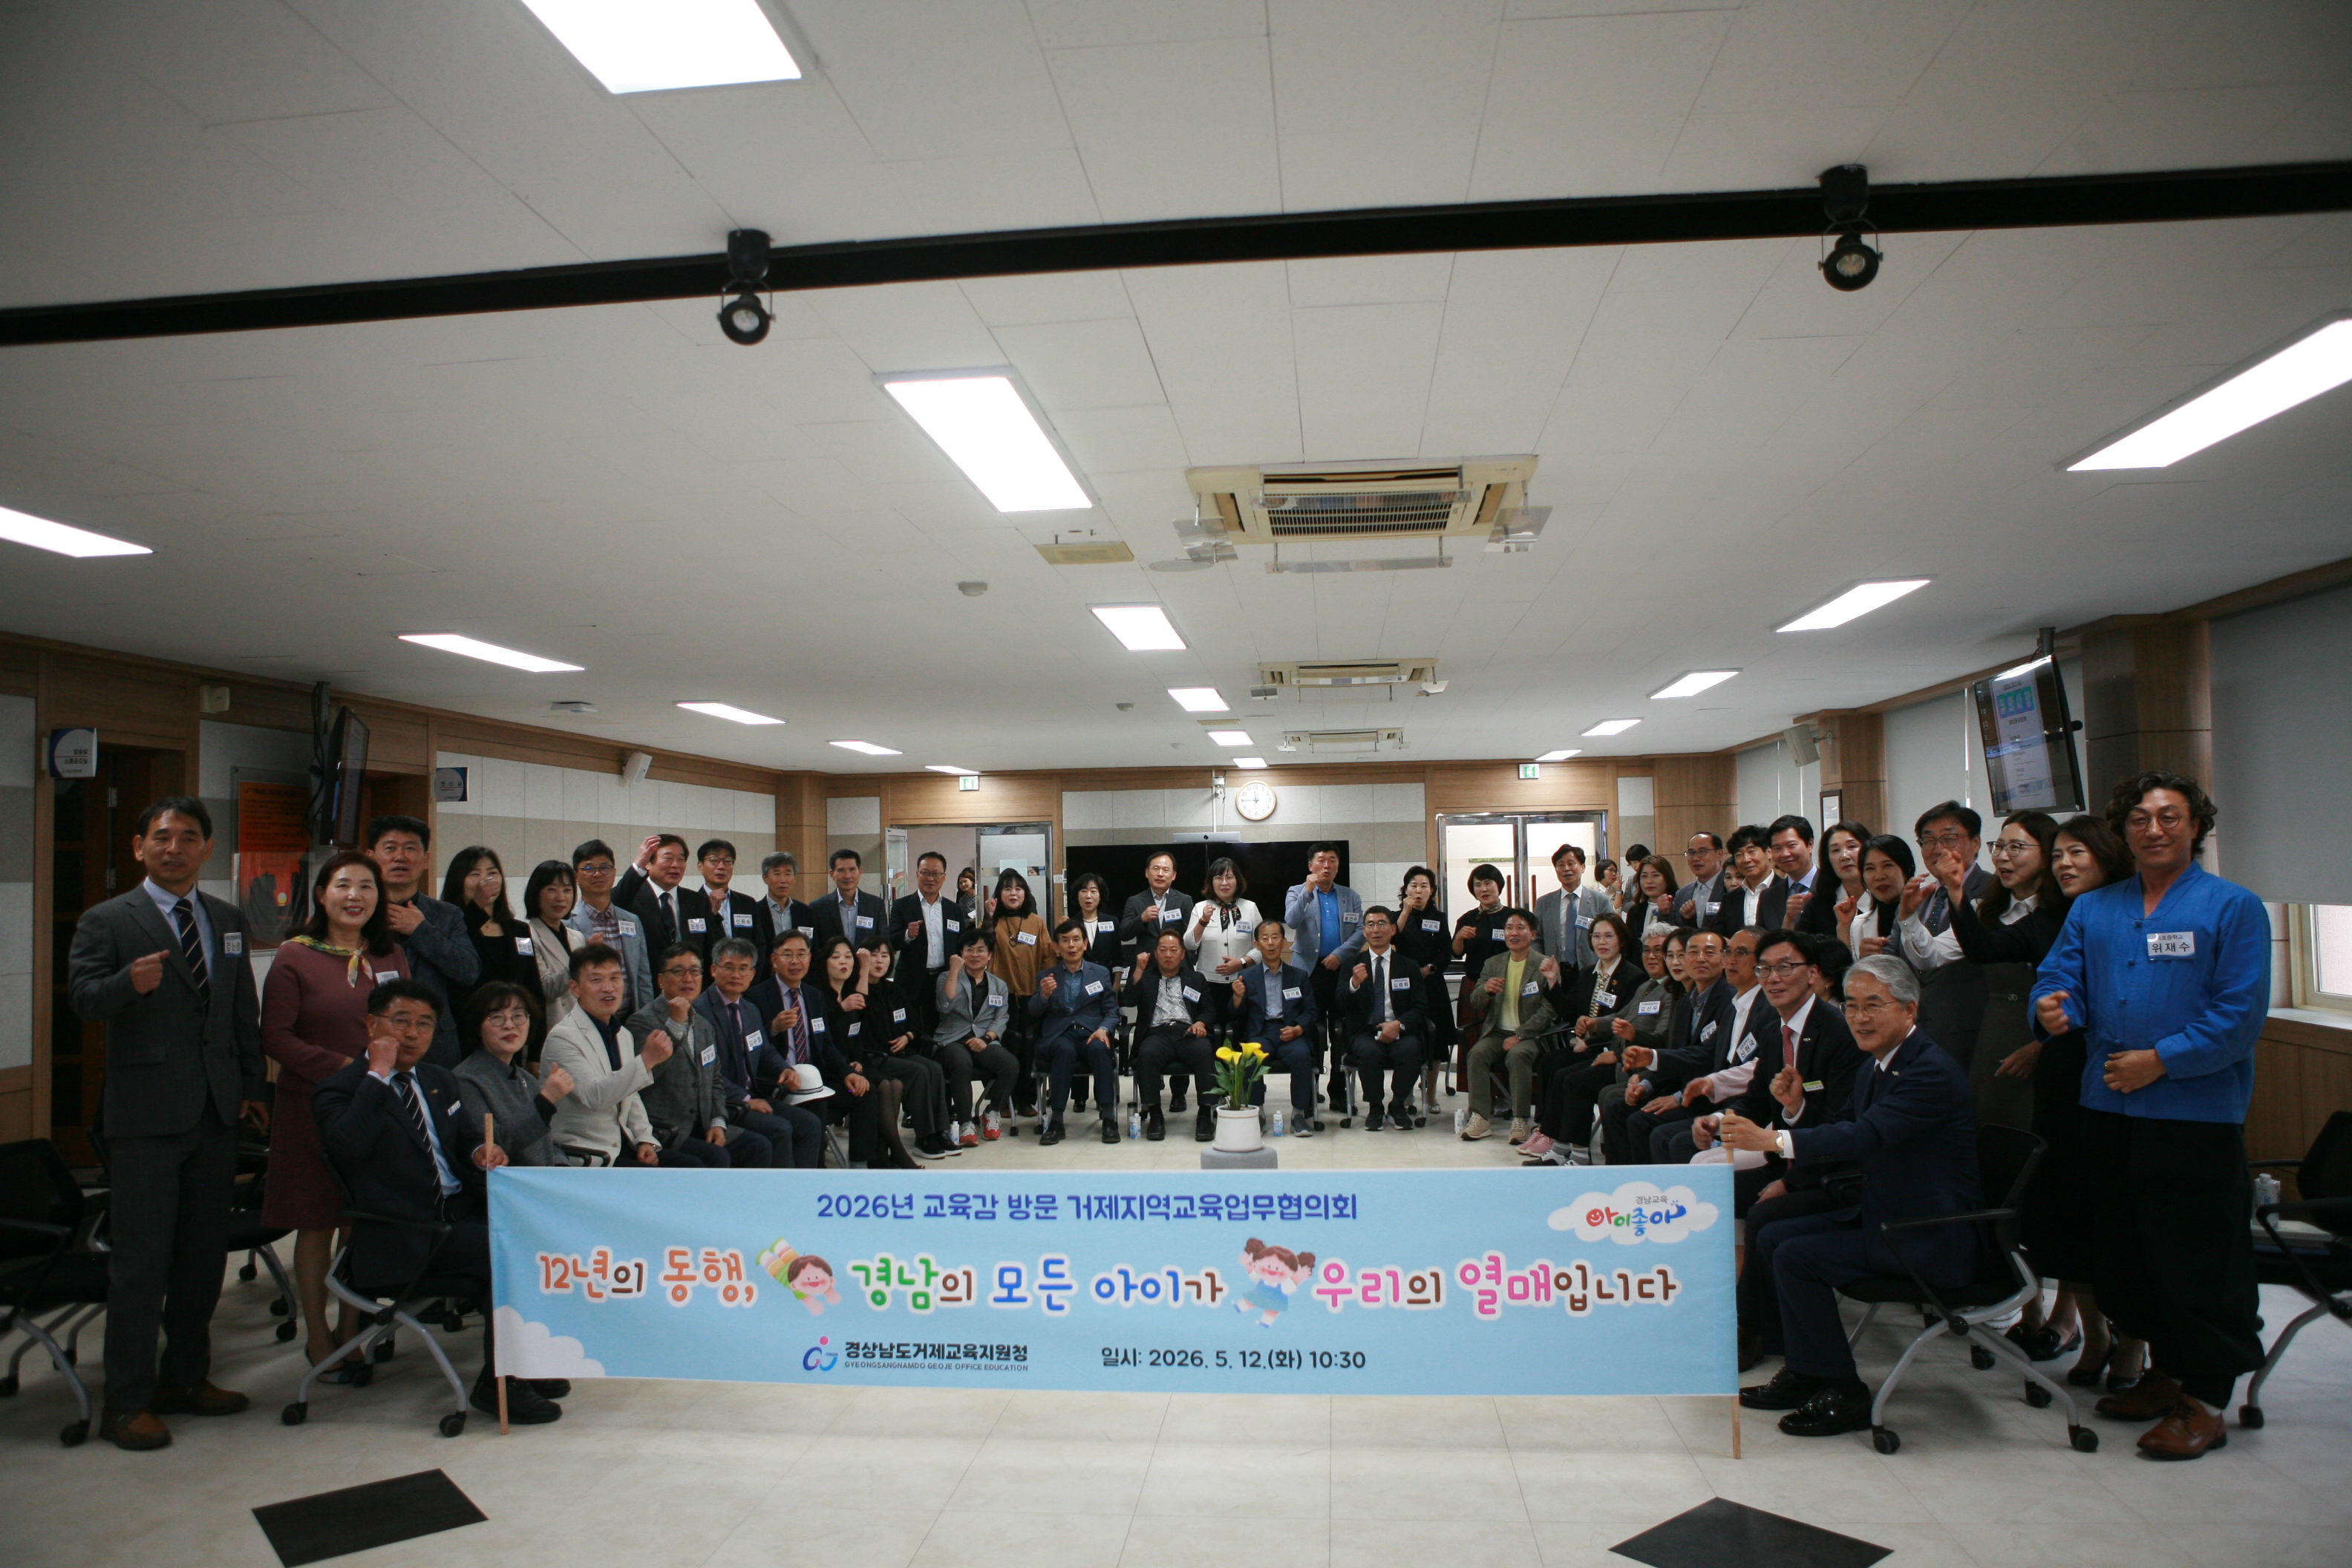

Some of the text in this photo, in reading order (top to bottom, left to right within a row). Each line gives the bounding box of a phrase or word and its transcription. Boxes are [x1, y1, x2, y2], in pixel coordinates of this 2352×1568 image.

[2152, 942, 2190, 953] 위재수
[818, 1193, 1357, 1221] 2026년 교육감 방문 거제지역교육업무협의회
[1636, 1195, 1667, 1204] 경남교육
[1586, 1200, 1686, 1236] 아이좋아
[541, 1250, 755, 1301] 12년의 동행,
[853, 1258, 1223, 1311] 경남의 모든 아이가
[1316, 1255, 1676, 1315] 우리의 열매입니다
[845, 1342, 1028, 1362] 경상남도거제교육지원청
[1101, 1347, 1366, 1370] 일시: 2026. 5. 12.(화) 10:30
[845, 1361, 926, 1369] GYEONGSANGNAMDO
